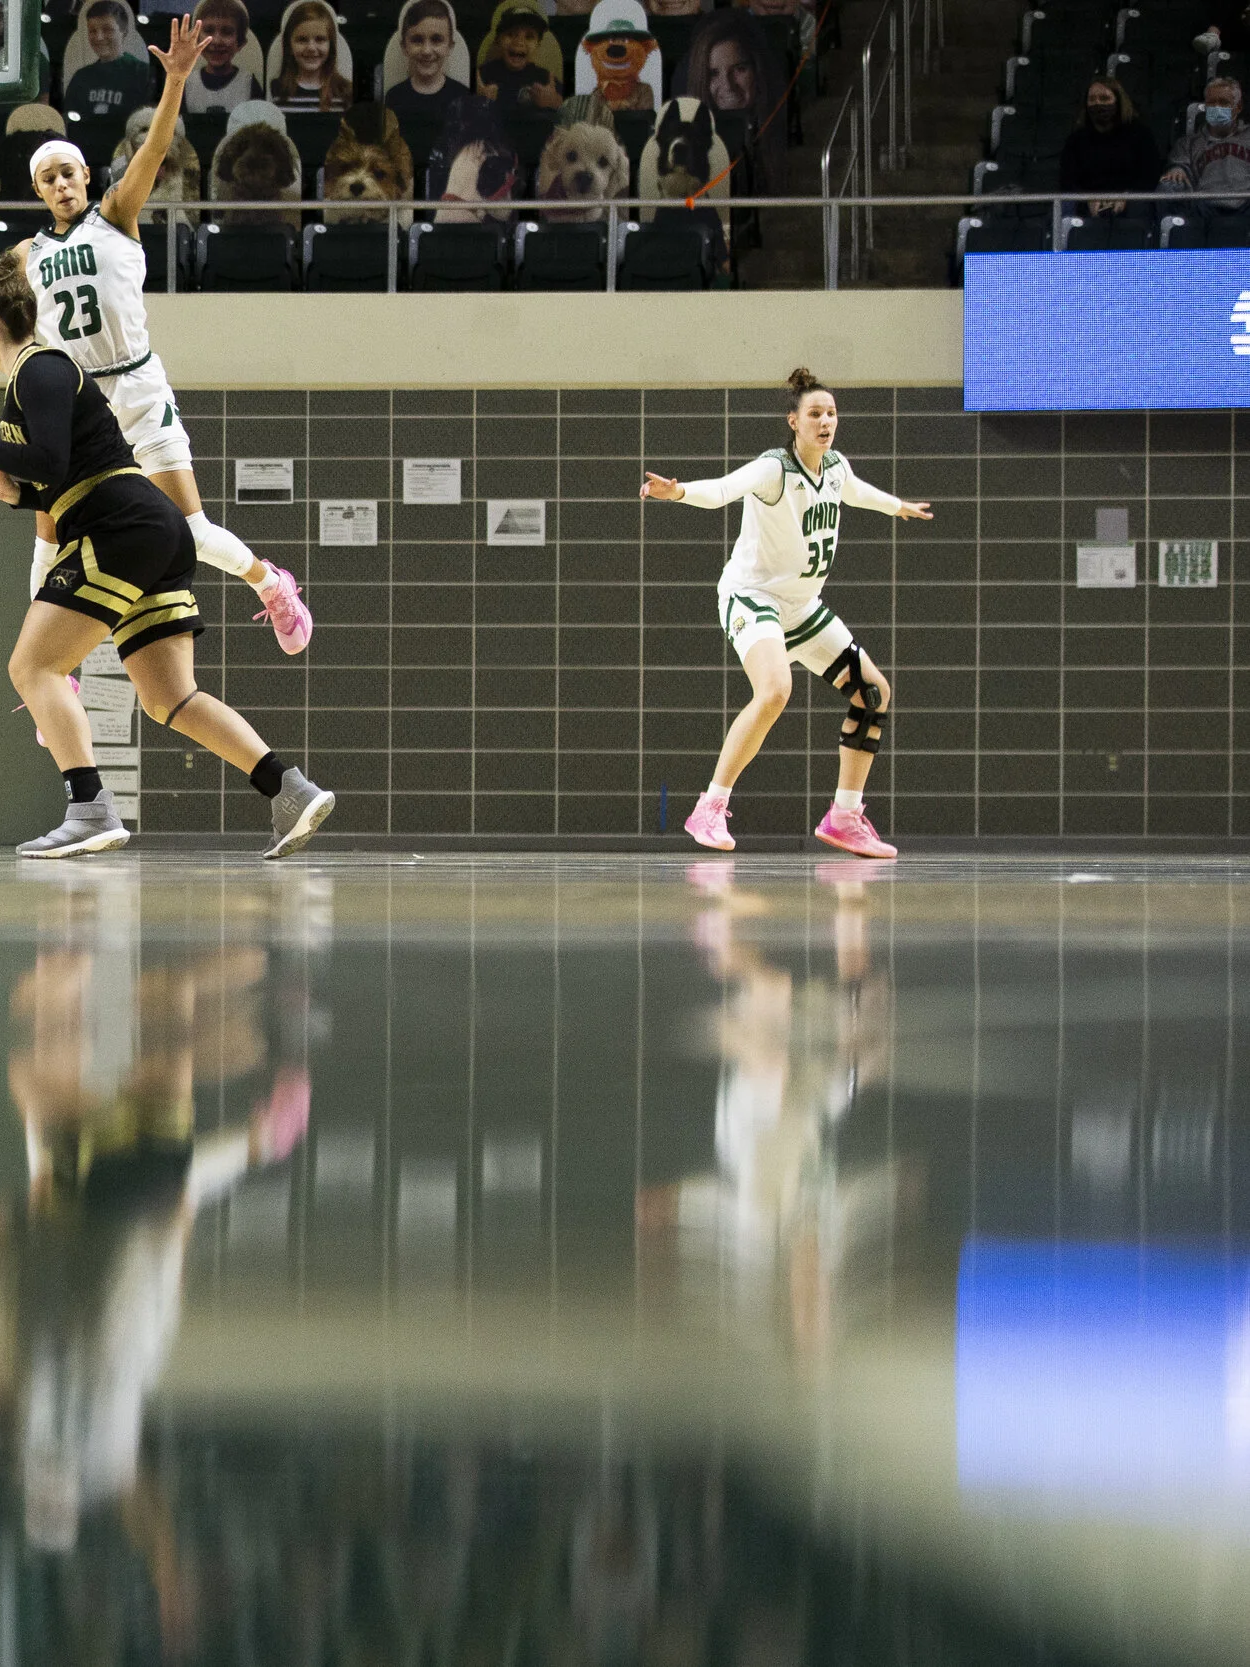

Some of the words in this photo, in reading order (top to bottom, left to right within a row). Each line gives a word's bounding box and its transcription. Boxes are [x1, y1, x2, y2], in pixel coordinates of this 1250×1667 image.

[89, 88, 123, 105] OHIO
[39, 243, 98, 290] OHIO
[53, 284, 102, 341] 23
[802, 501, 838, 537] OHIO
[799, 536, 834, 579] 35
